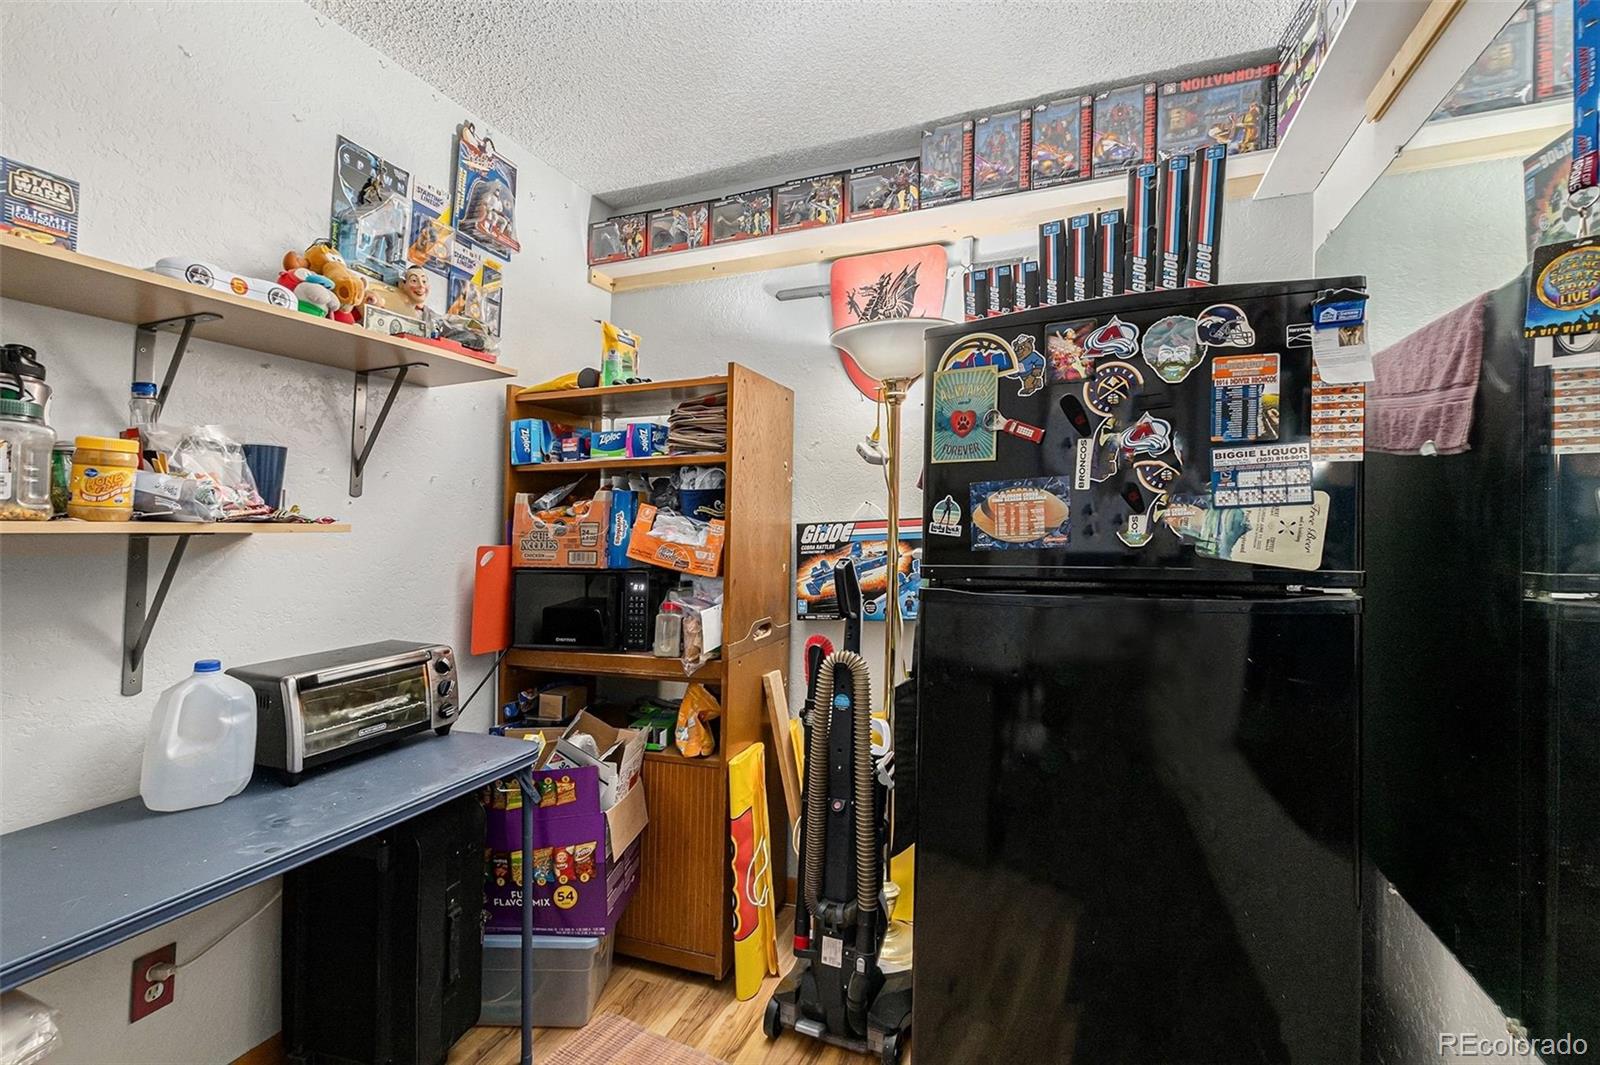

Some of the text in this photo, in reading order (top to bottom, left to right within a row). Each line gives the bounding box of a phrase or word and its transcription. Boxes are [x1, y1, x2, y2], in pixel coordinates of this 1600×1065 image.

[13, 176, 70, 204] WARS
[18, 172, 68, 194] STAR
[14, 212, 68, 232] CONTROLLER
[15, 204, 69, 226] FLIGHT
[1560, 290, 1590, 305] LIVE
[1563, 324, 1582, 333] VIP
[518, 427, 530, 454] Ziploc
[599, 431, 622, 446] Ziploc
[638, 428, 649, 453] Ziploc
[942, 441, 981, 457] FOREVER
[1214, 446, 1308, 460] BIGGIE LIQUOR
[1078, 439, 1088, 488] BRONCOS
[1308, 503, 1321, 526] Free
[530, 530, 550, 542] CUP
[614, 510, 625, 546] Twinkies
[520, 540, 559, 551] NOODLES
[1304, 527, 1318, 554] Beer
[532, 898, 550, 907] MIX
[557, 891, 575, 902] 54
